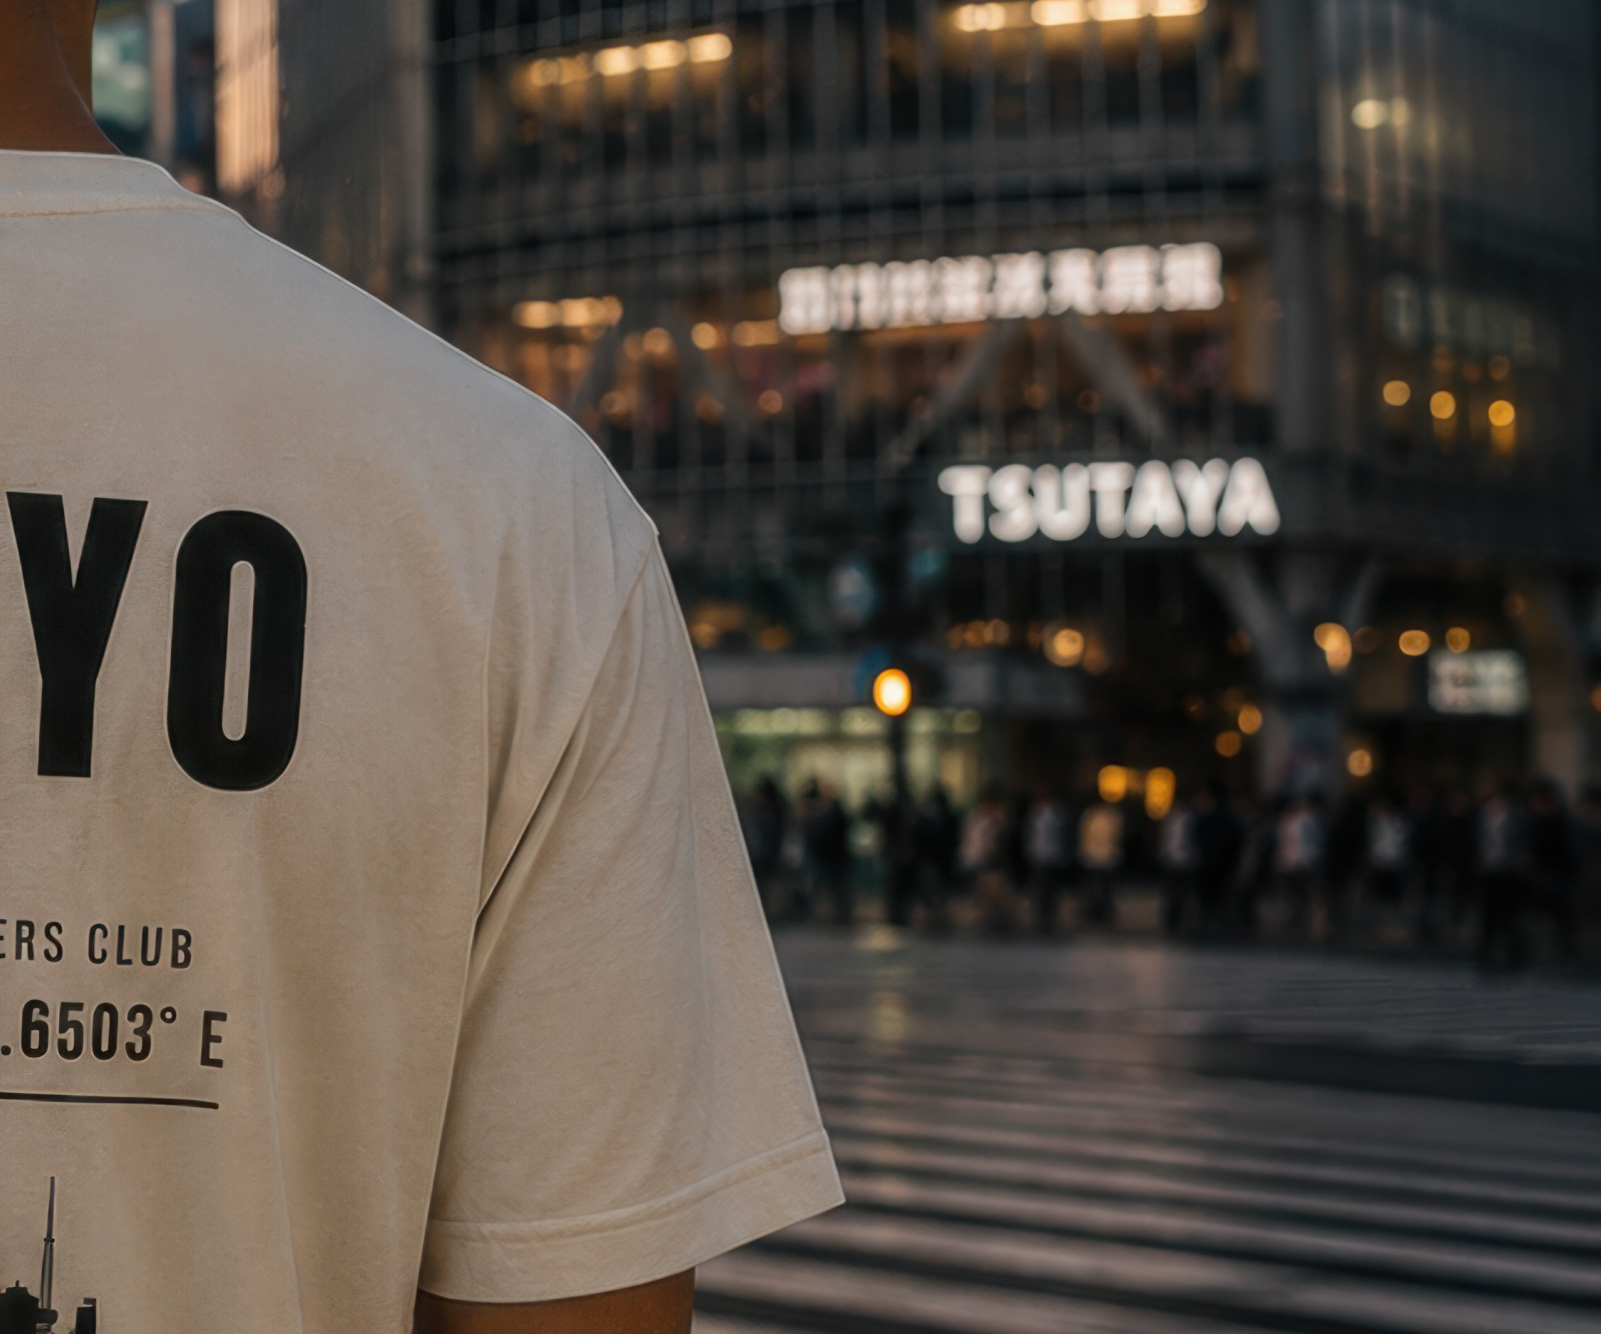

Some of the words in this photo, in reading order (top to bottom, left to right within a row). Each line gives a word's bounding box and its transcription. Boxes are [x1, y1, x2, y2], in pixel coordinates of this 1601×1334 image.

[938, 457, 1281, 545] TSUTAYA
[88, 923, 193, 969] CLUB
[200, 1010, 229, 1069] E
